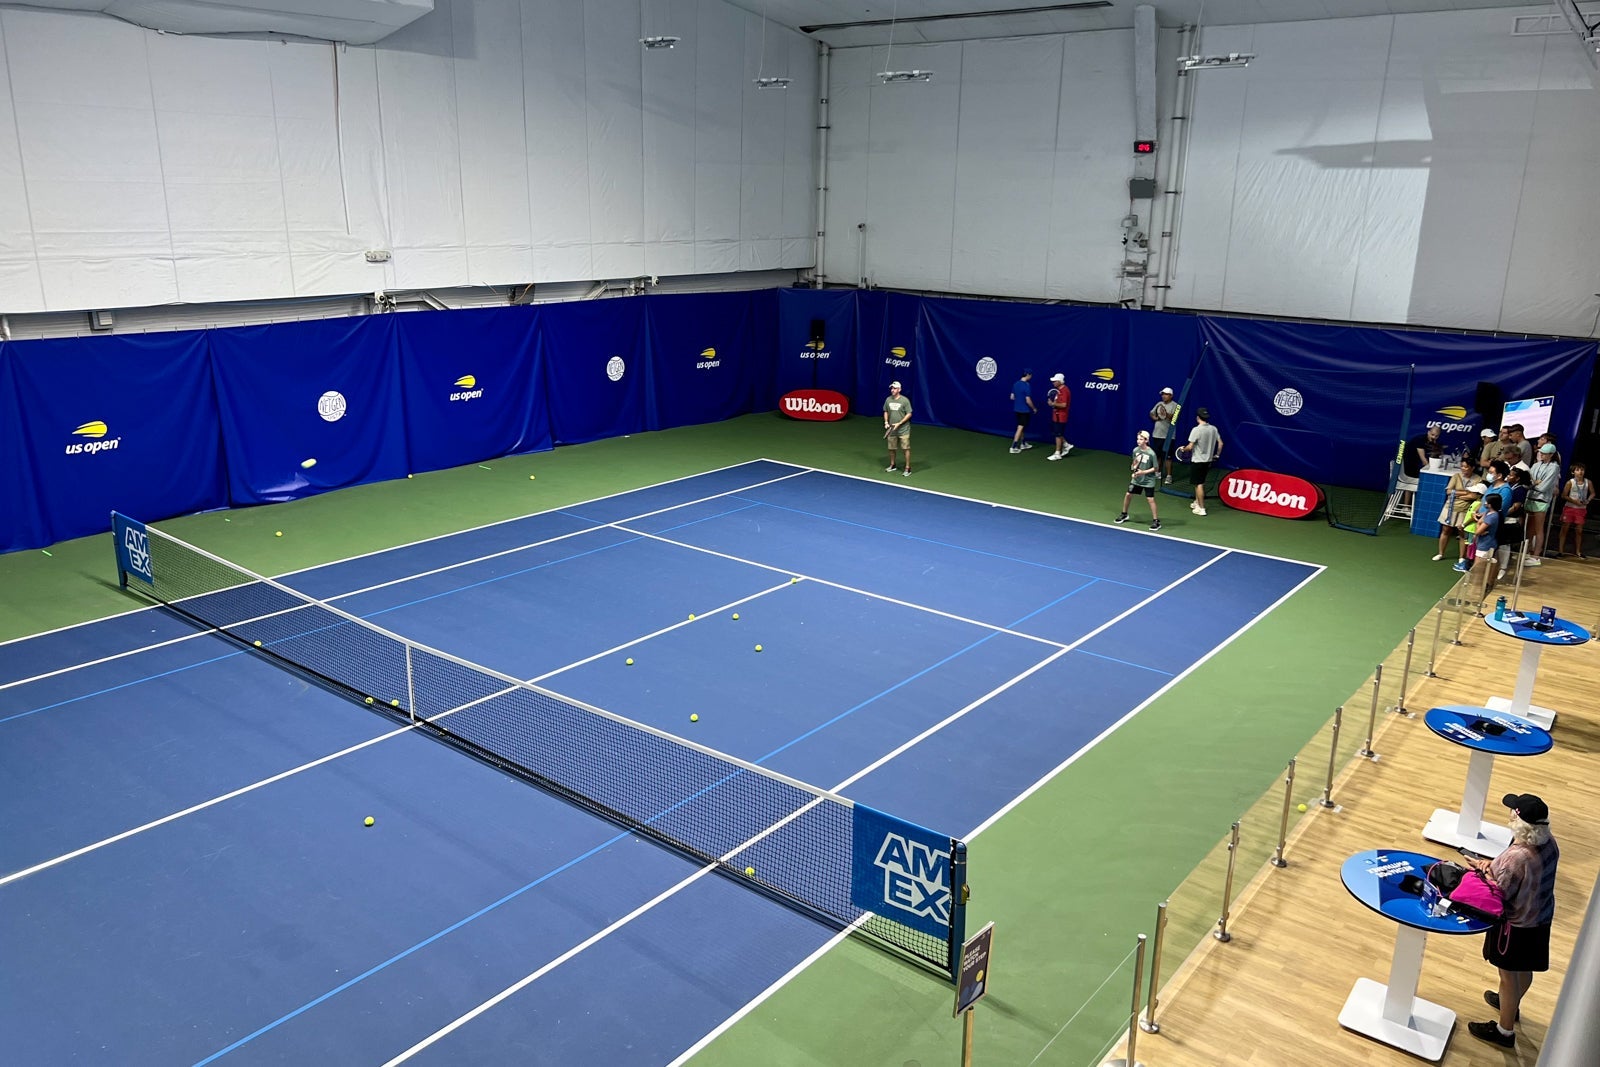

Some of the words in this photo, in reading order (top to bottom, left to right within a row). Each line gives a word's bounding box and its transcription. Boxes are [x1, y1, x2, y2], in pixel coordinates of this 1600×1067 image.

[696, 361, 704, 369] us
[704, 360, 720, 370] open
[892, 359, 911, 368] open
[1085, 381, 1095, 389] us
[1096, 382, 1119, 392] open
[450, 393, 460, 402] us
[461, 390, 482, 402] open
[319, 396, 346, 414] NETGEN
[785, 397, 843, 414] Wilson
[1426, 420, 1442, 429] us
[1441, 422, 1473, 433] open
[65, 443, 83, 455] us
[84, 438, 119, 455] open
[1228, 477, 1308, 511] Wilson
[874, 831, 951, 893] AM
[884, 864, 951, 926] EX
